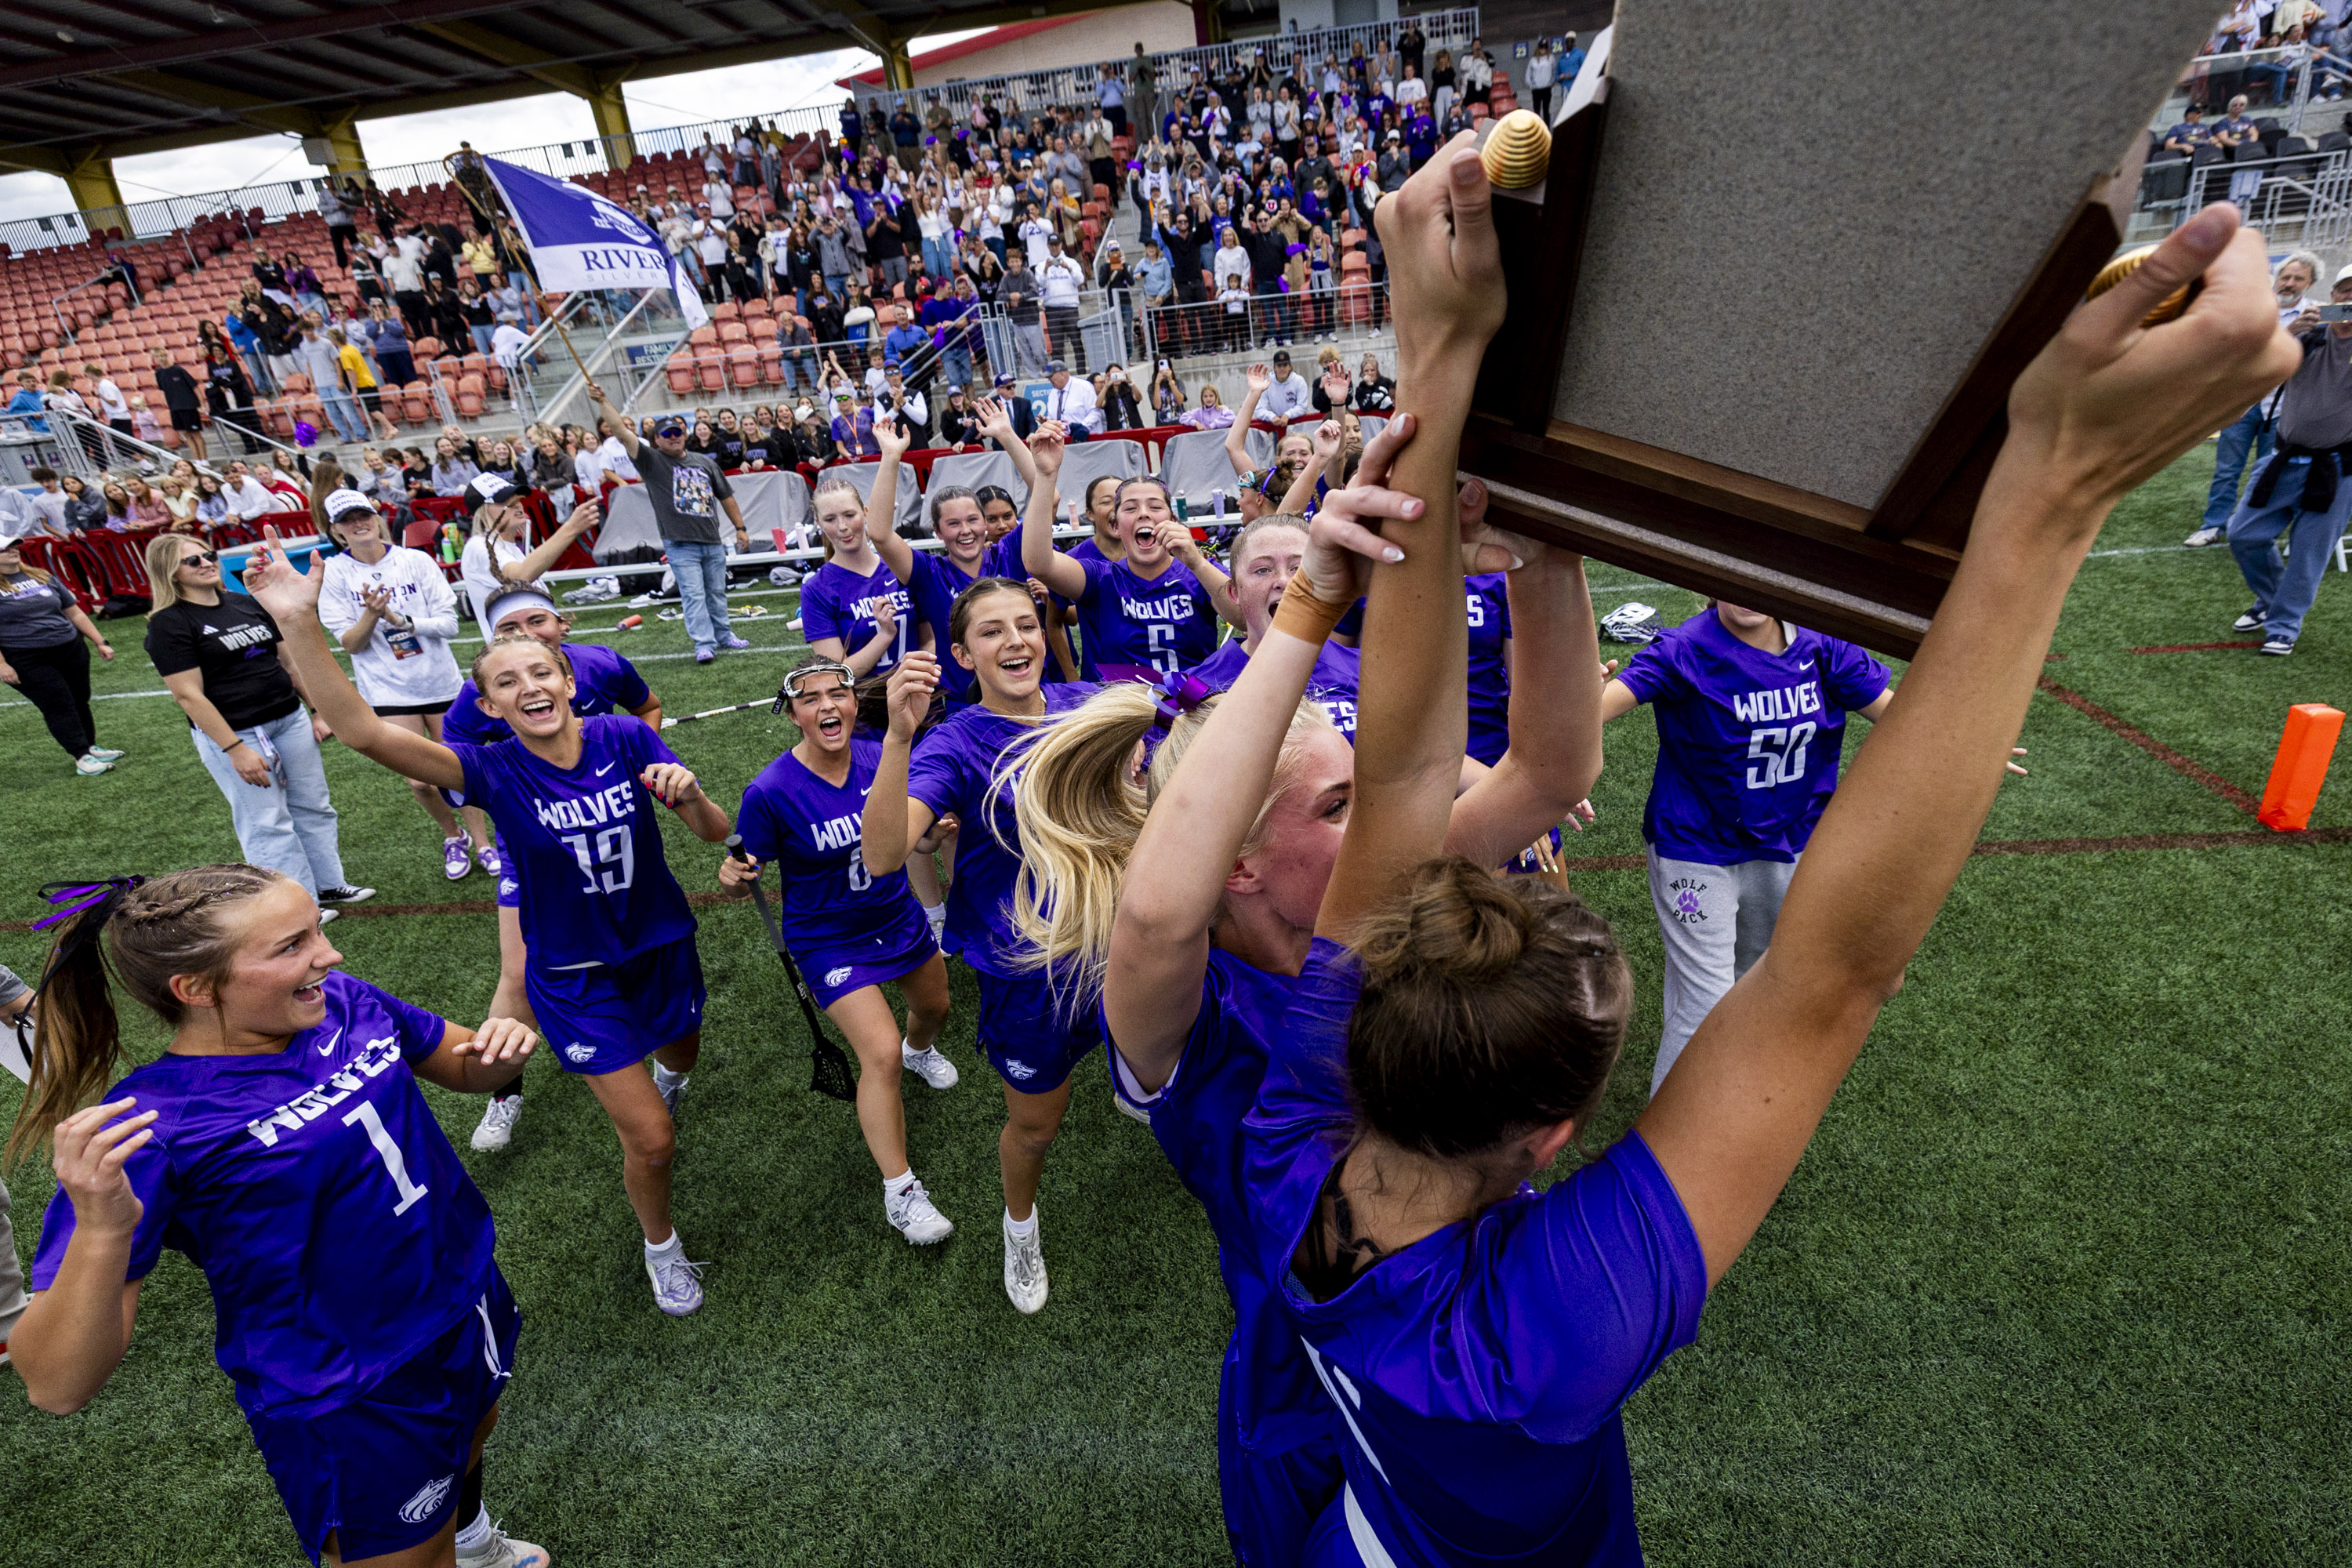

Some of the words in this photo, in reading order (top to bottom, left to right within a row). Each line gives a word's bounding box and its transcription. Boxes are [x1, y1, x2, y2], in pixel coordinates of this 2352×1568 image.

[1121, 594, 1194, 620] WOLVES
[218, 625, 273, 652] WOLVES
[1147, 624, 1180, 676] 5
[1733, 681, 1820, 723] WOLVES
[1747, 720, 1817, 789] 50
[534, 780, 635, 829] WOLVES
[561, 824, 634, 895] 19
[1669, 878, 1708, 892] WOLF
[1673, 909, 1708, 924] PACK
[247, 1036, 401, 1148] WOLVES
[341, 1099, 429, 1217] 1
